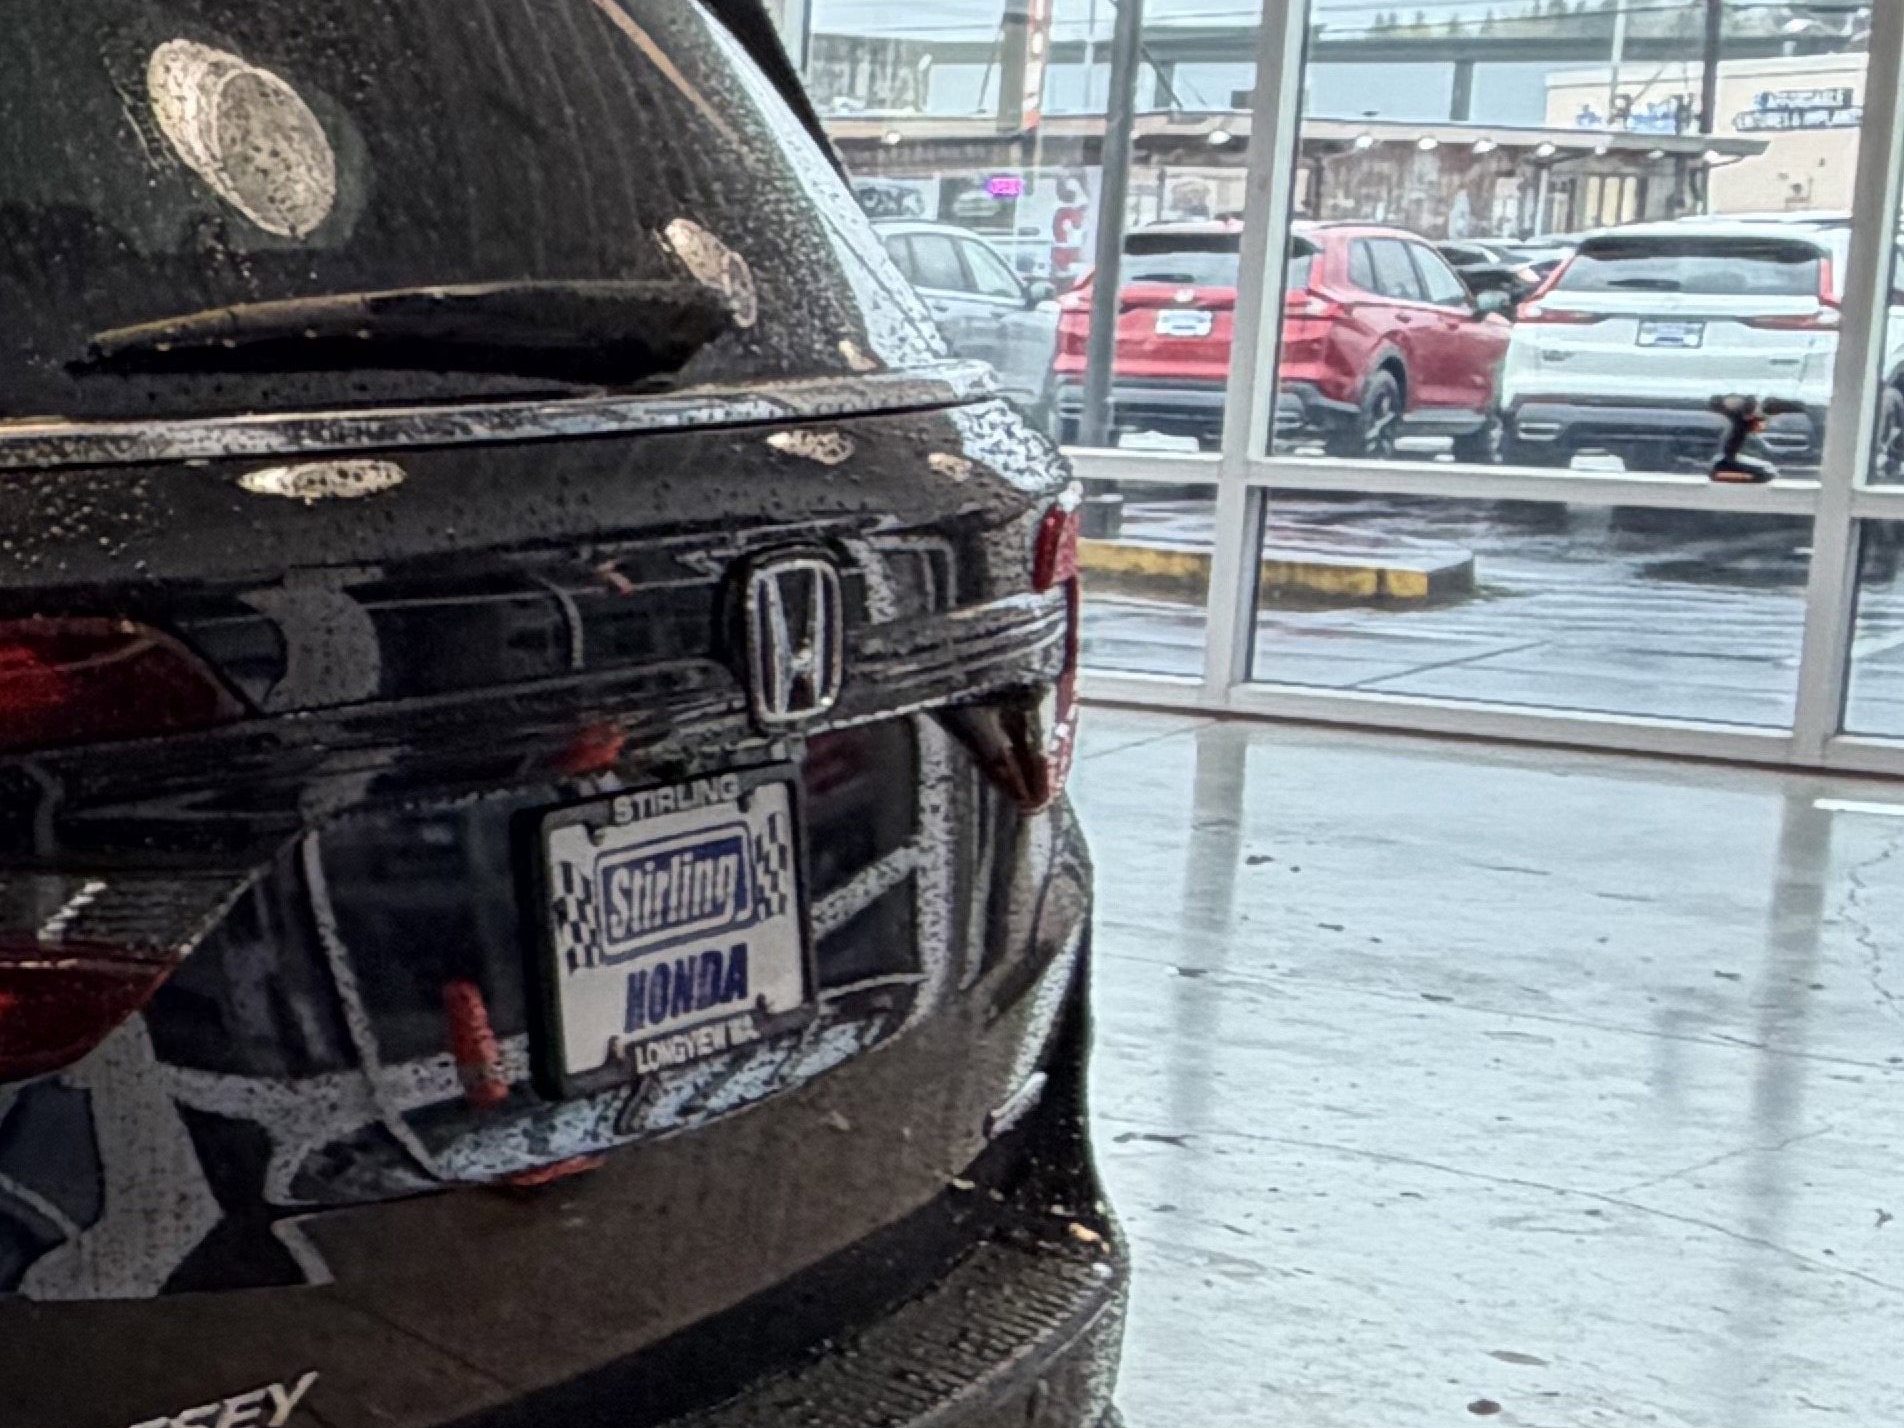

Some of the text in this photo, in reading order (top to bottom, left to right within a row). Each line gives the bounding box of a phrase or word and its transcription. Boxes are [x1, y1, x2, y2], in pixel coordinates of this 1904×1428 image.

[613, 773, 740, 823] STIRLING
[610, 852, 739, 938] Stirling
[624, 942, 748, 1033] HONDA
